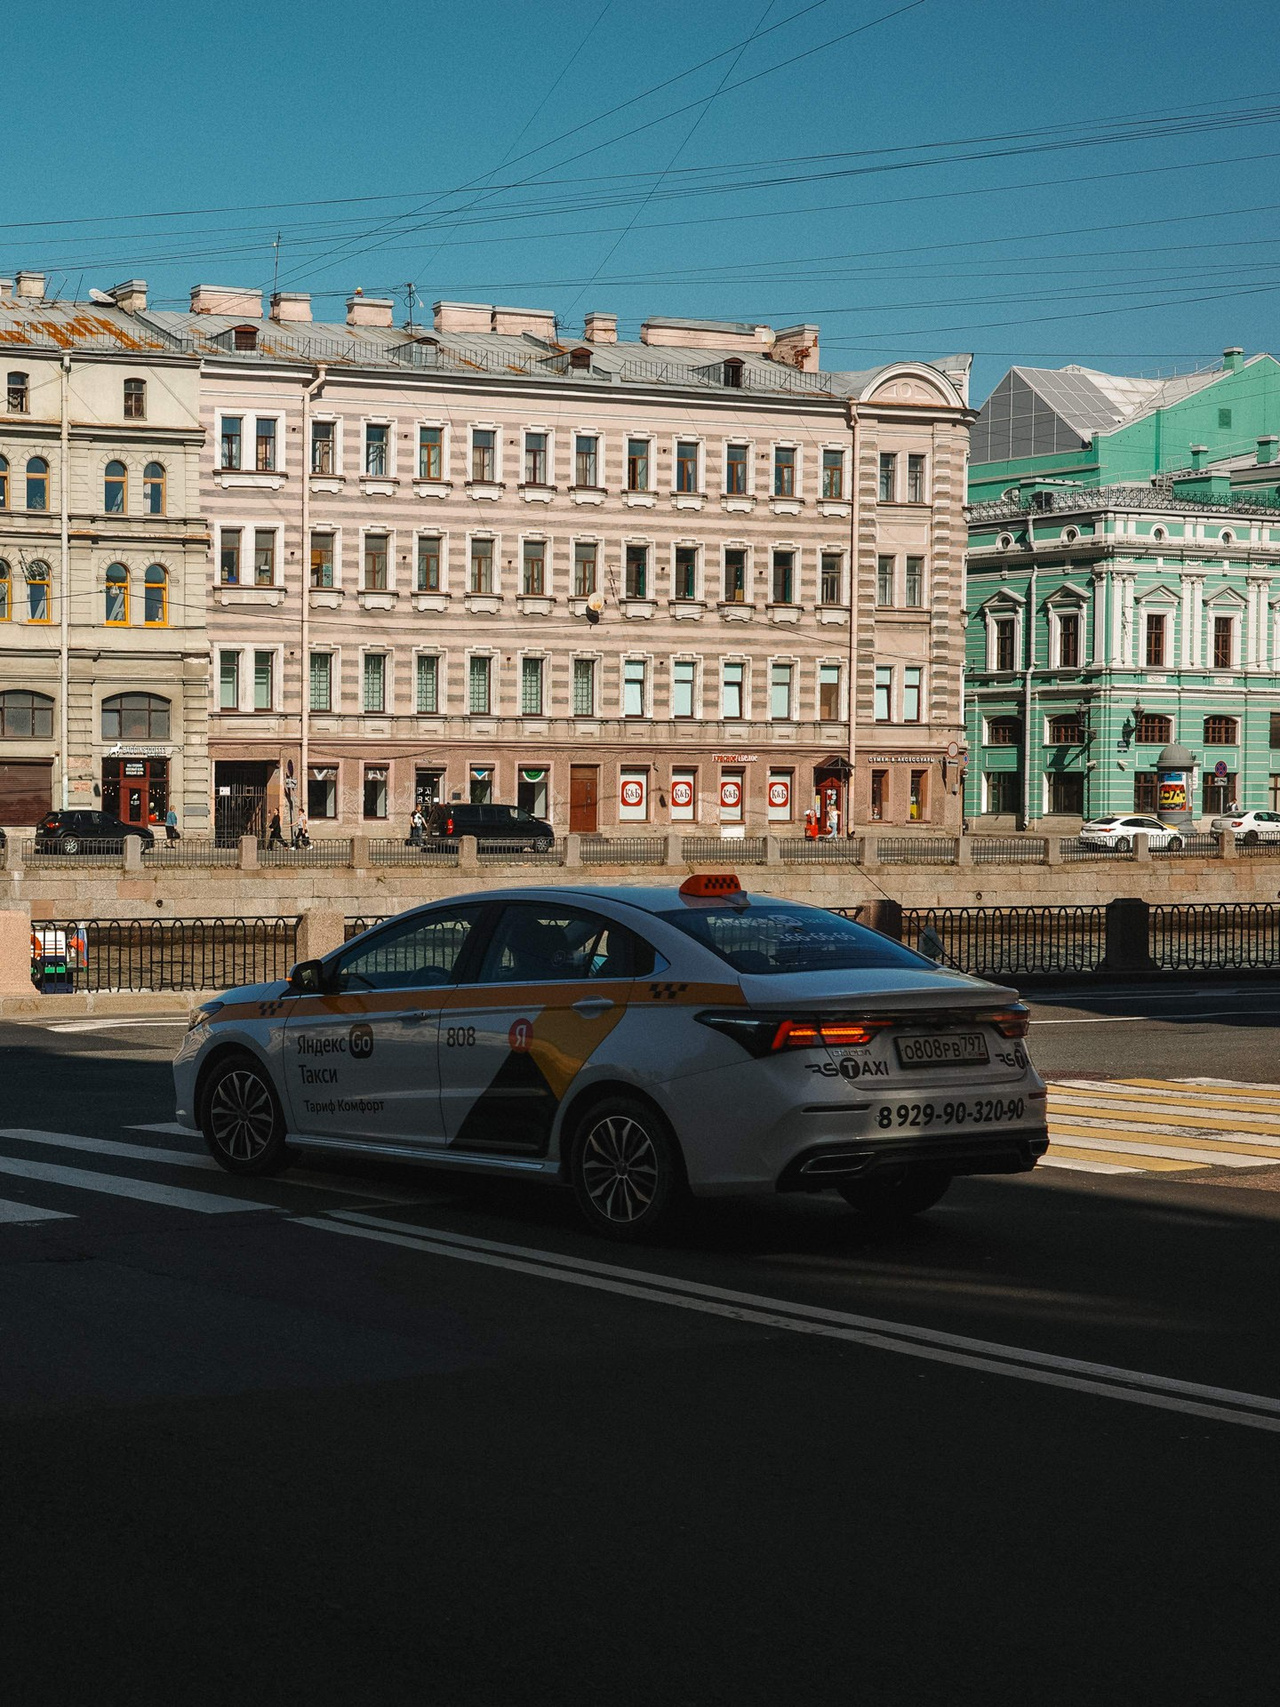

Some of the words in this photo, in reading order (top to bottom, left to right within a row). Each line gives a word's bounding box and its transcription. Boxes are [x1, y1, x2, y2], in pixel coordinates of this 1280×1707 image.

[297, 1034, 346, 1057] Яндекс
[351, 1030, 371, 1052] Go
[446, 1026, 476, 1048] 808
[961, 1036, 981, 1051] 797
[298, 1064, 338, 1085] Такси
[304, 1099, 336, 1115] Тариф
[337, 1098, 385, 1114] Комфорт
[878, 1106, 893, 1128] 8
[898, 1097, 1025, 1127] 929-90-320-90
